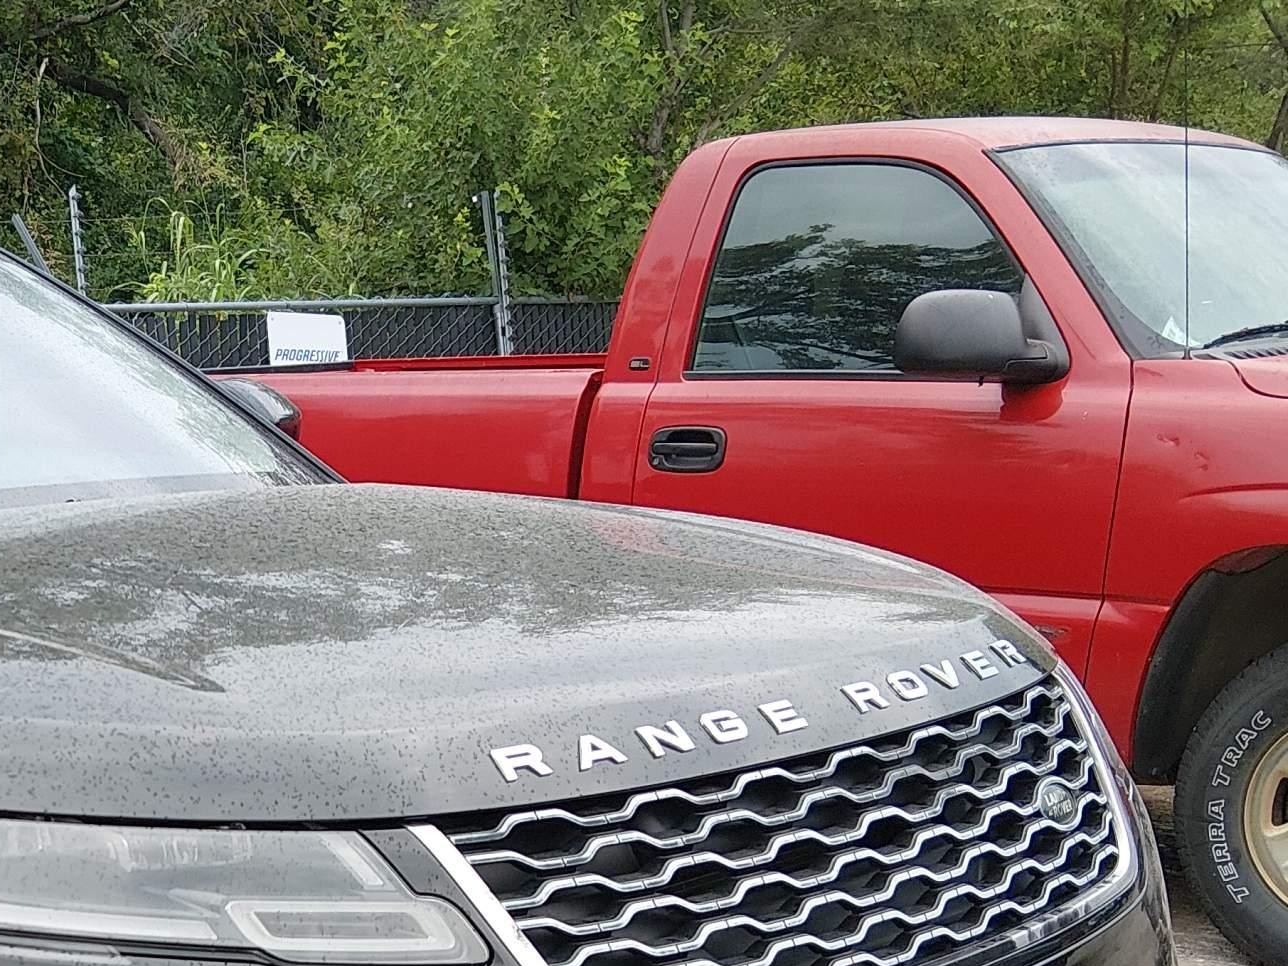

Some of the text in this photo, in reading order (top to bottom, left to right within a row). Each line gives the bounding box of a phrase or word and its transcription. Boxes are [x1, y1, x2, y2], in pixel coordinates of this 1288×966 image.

[274, 348, 342, 363] PROGRESSIVE
[489, 638, 1028, 783] RANGE ROVER
[1207, 710, 1272, 904] TERRA TRAC
